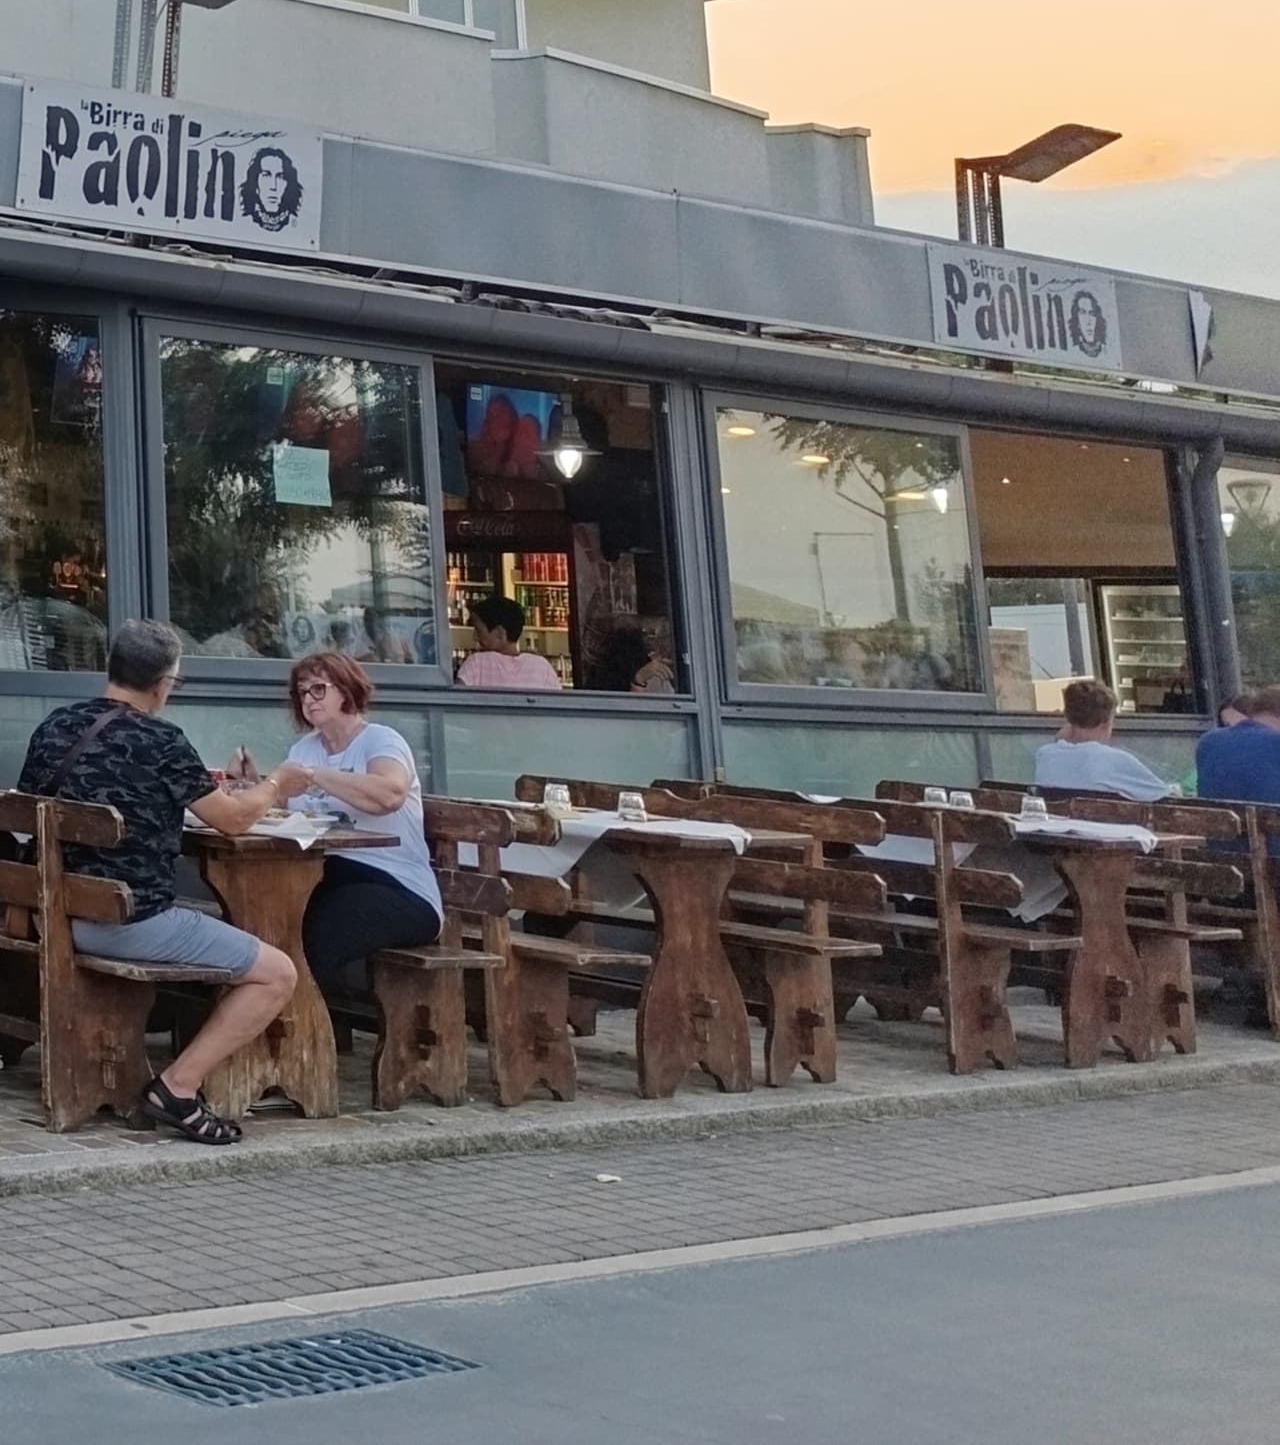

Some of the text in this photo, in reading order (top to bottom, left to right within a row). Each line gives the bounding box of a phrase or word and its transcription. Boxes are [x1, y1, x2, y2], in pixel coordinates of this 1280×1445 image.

[90, 101, 145, 131] Birra
[151, 118, 164, 135] di
[970, 258, 1005, 280] Birra
